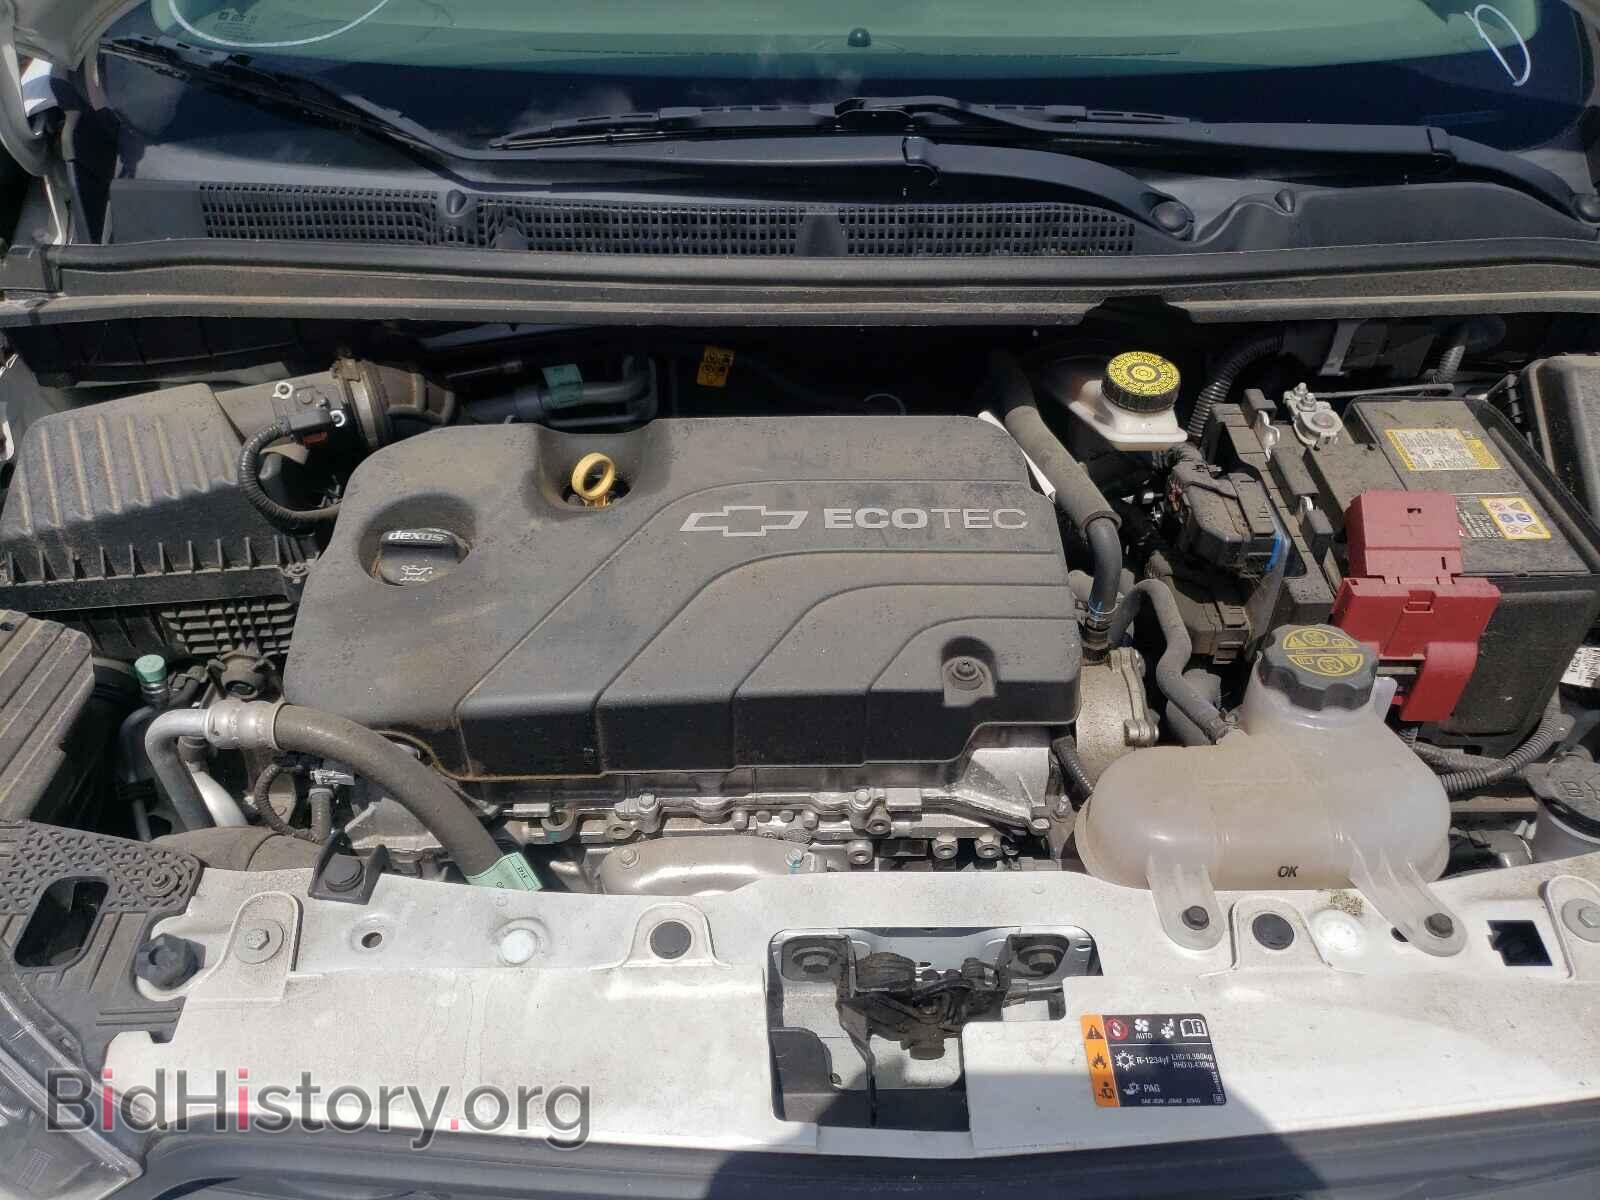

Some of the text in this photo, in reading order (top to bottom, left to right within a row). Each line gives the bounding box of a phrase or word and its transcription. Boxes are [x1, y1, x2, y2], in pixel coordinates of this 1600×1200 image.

[823, 508, 1029, 529] ECOTEC
[388, 531, 448, 542] dexos
[1277, 865, 1298, 878] OK
